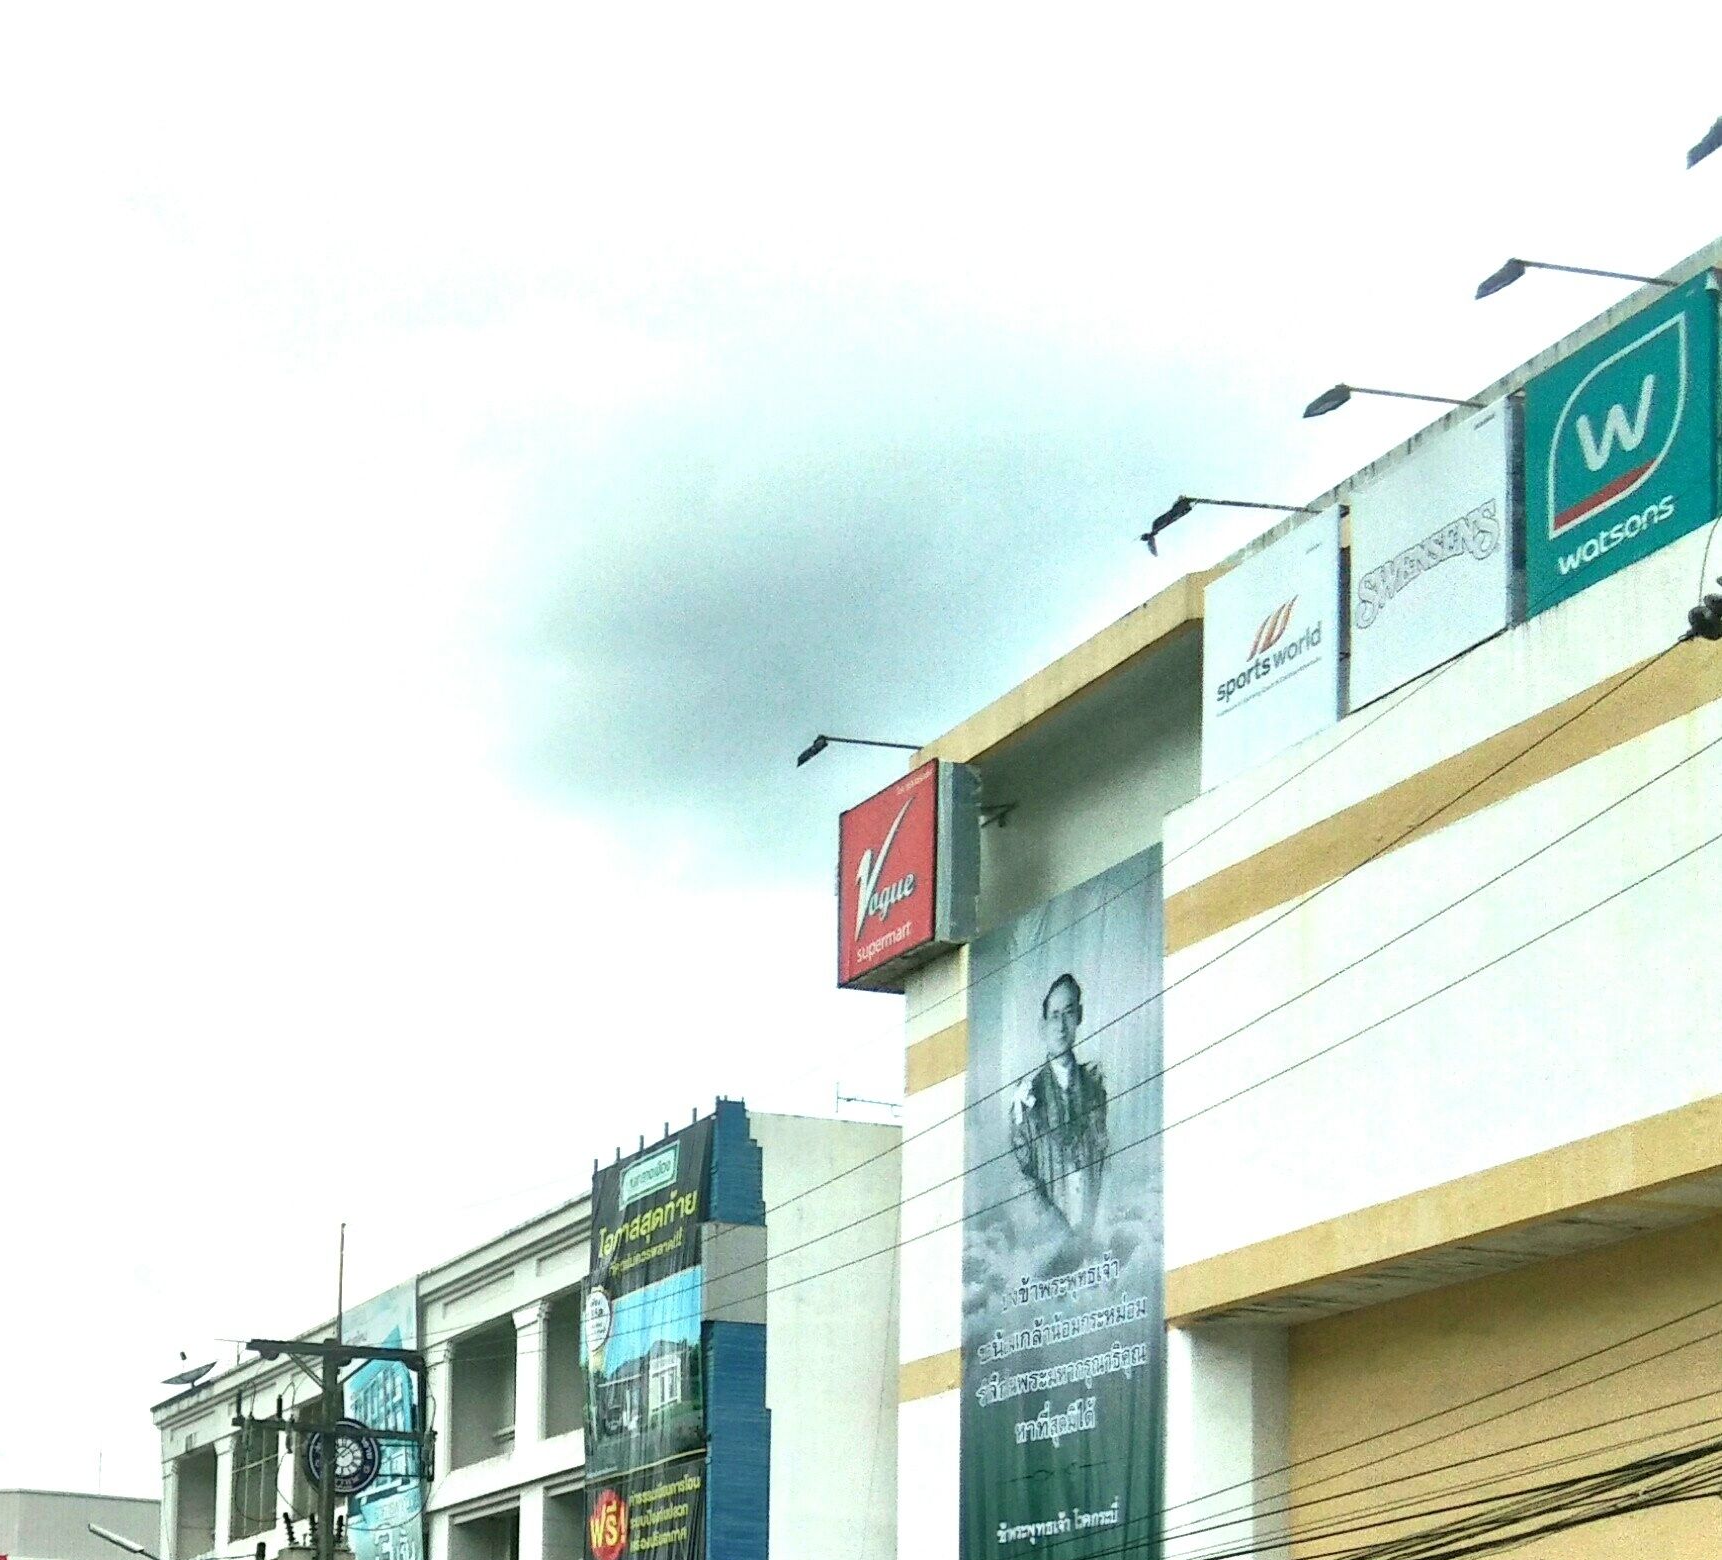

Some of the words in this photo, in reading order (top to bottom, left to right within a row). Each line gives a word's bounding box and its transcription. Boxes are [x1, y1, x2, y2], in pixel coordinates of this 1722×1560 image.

[1557, 494, 1676, 575] watsons
[854, 796, 915, 942] Vogue
[857, 921, 913, 963] supermart
